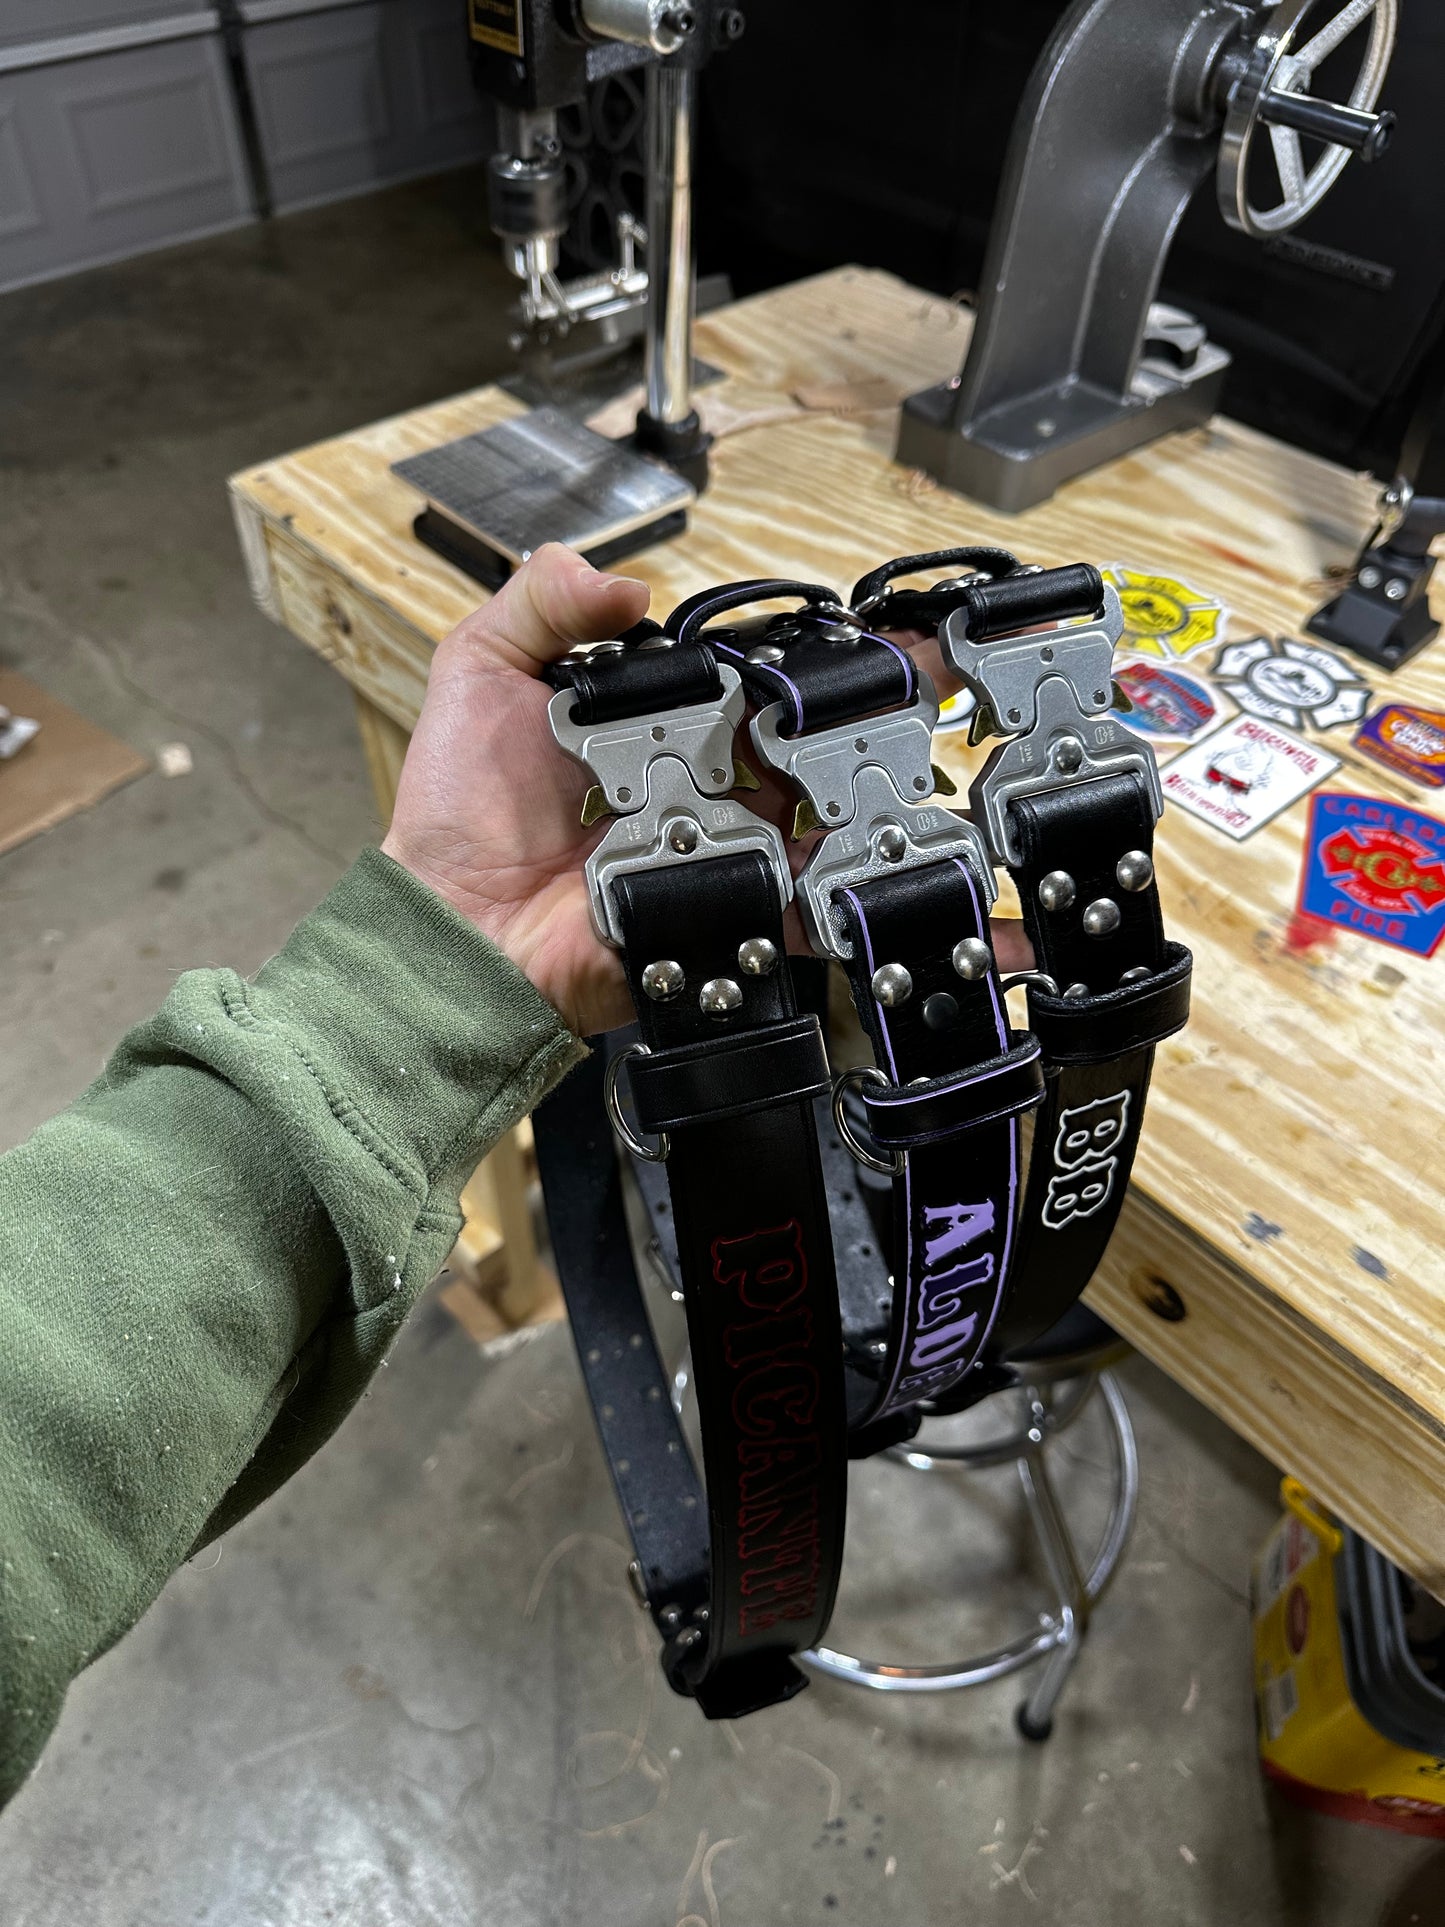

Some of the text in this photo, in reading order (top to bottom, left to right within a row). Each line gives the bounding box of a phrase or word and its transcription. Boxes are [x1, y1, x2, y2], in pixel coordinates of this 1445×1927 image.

[1330, 899, 1407, 940] FIRE
[1042, 1089, 1132, 1230] BB
[890, 1197, 995, 1406] ALDE
[712, 1218, 822, 1636] PICANTE
